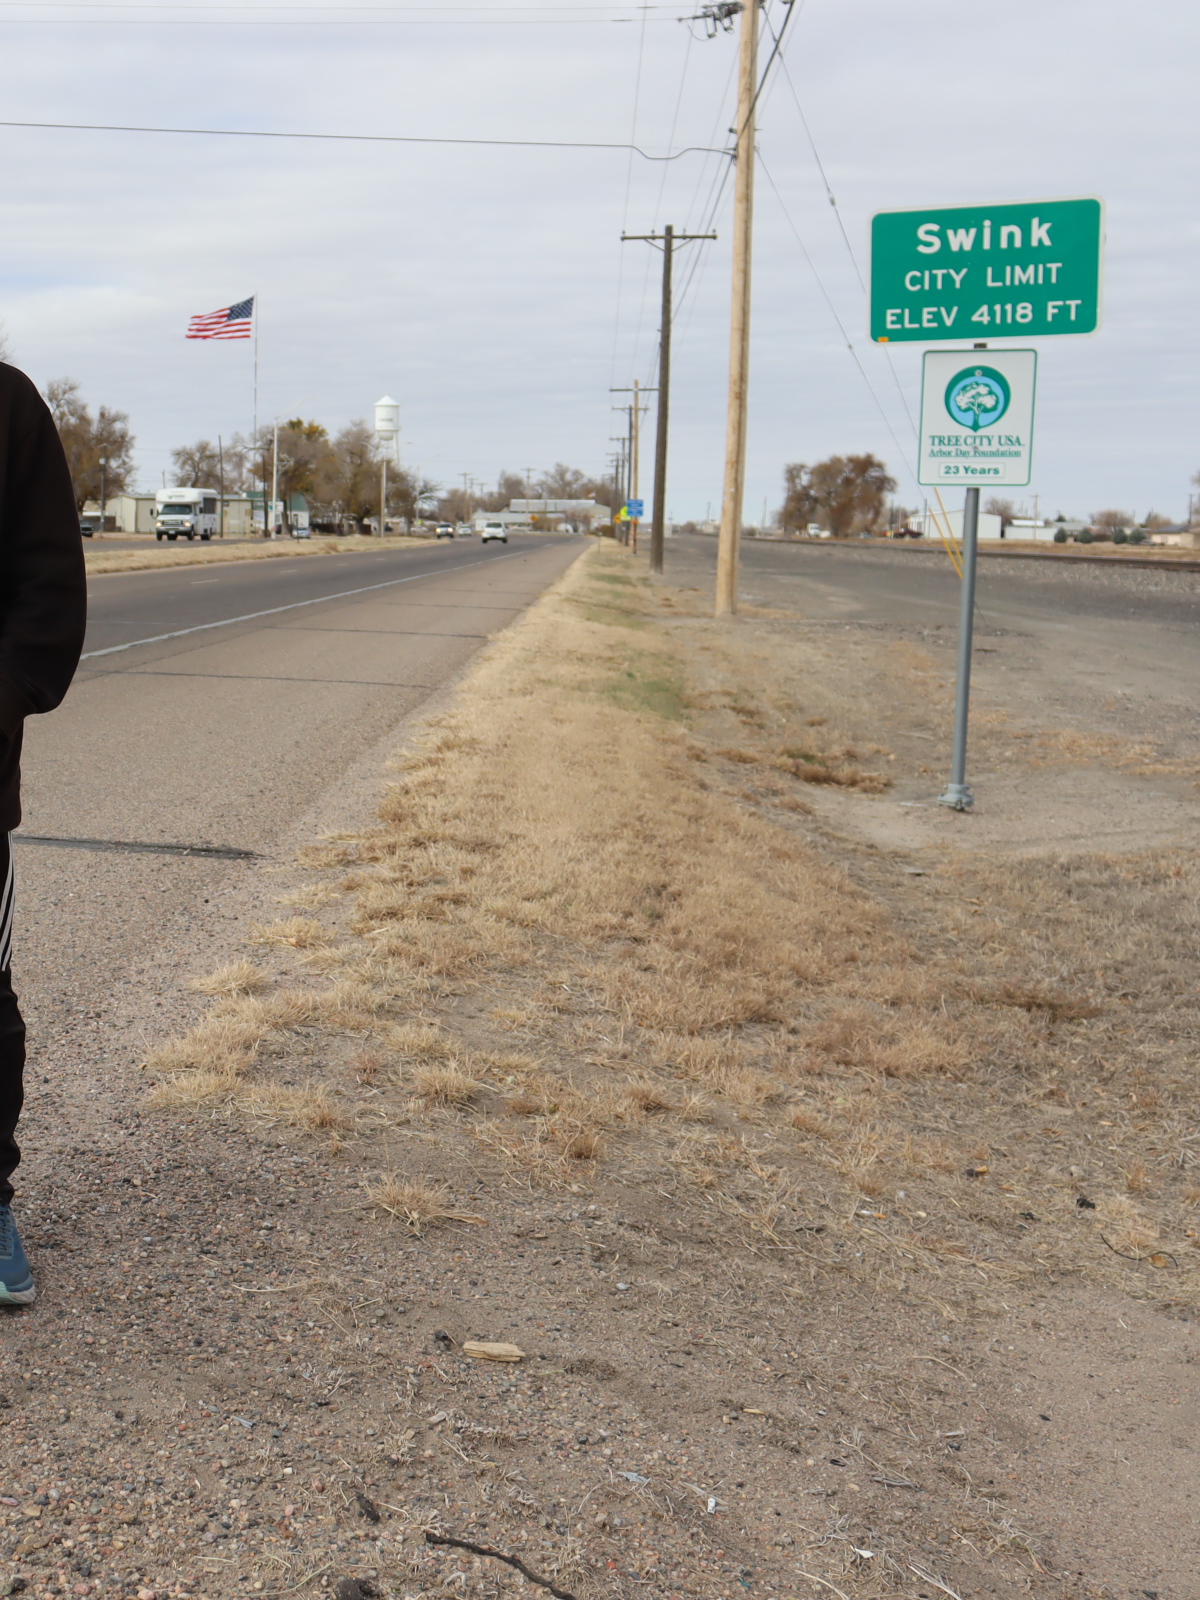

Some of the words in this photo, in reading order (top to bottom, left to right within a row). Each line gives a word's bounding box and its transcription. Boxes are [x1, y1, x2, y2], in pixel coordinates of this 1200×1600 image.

[916, 217, 1053, 255] Swink
[904, 268, 968, 291] CITY
[986, 263, 1062, 287] LIMIT
[885, 305, 958, 330] ELEV
[971, 302, 1033, 325] 4118
[1046, 300, 1082, 322] FT
[929, 434, 962, 446] TREE
[964, 434, 994, 446] CITY
[998, 434, 1023, 446] USA
[929, 448, 953, 457] Arbor
[955, 448, 971, 458] Day
[973, 448, 1021, 457] Foundation
[944, 465, 960, 475] 23
[963, 465, 1000, 475] Years
